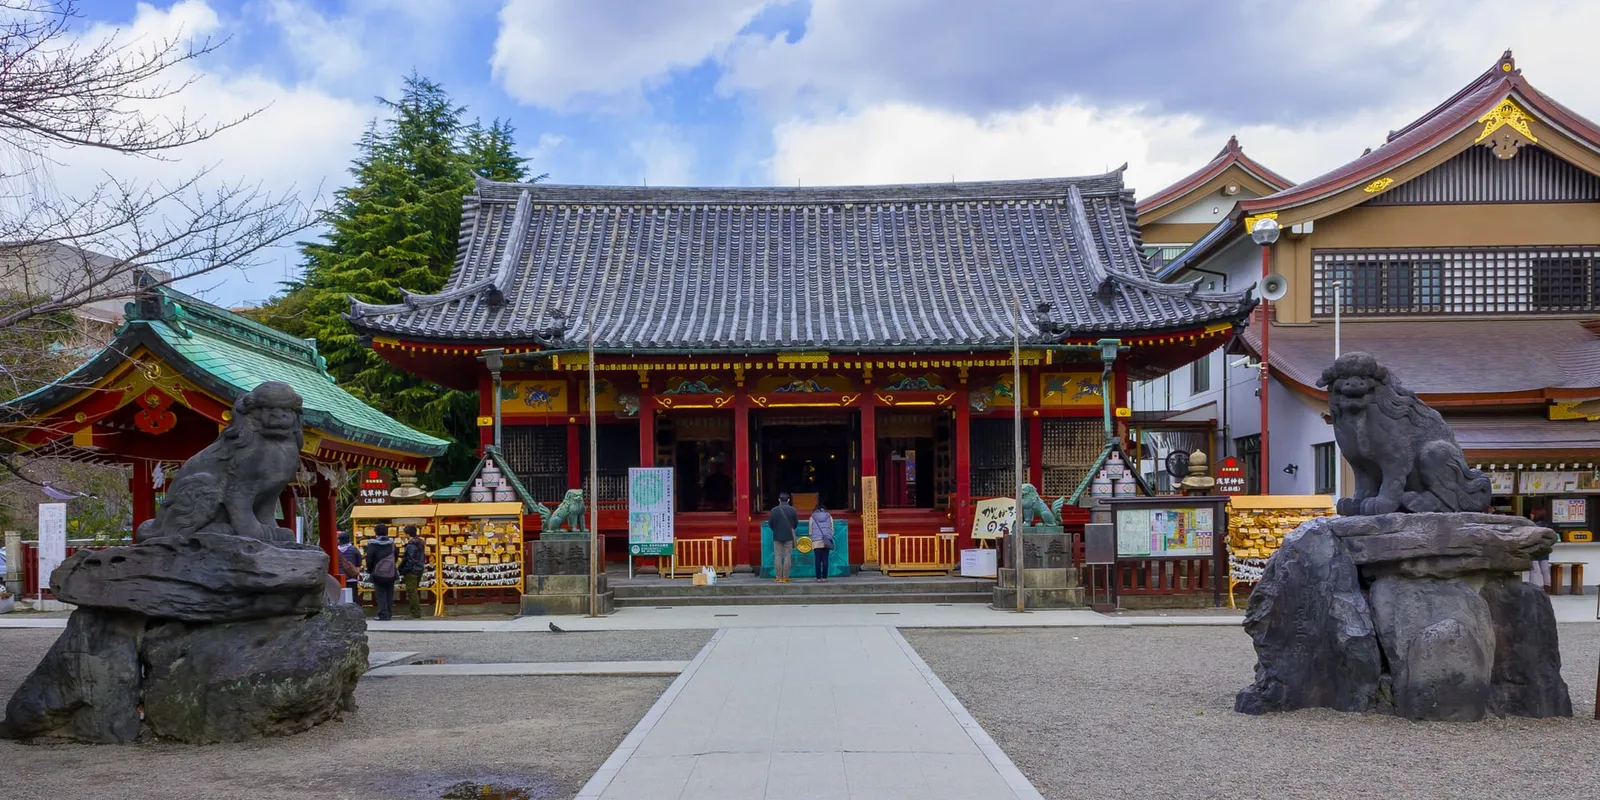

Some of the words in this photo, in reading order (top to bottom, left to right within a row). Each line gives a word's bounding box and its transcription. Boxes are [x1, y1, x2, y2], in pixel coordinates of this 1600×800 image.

[1216, 477, 1245, 485] 浅草神社
[360, 489, 389, 497] 浅草神社
[981, 506, 1017, 520] がんばろ
